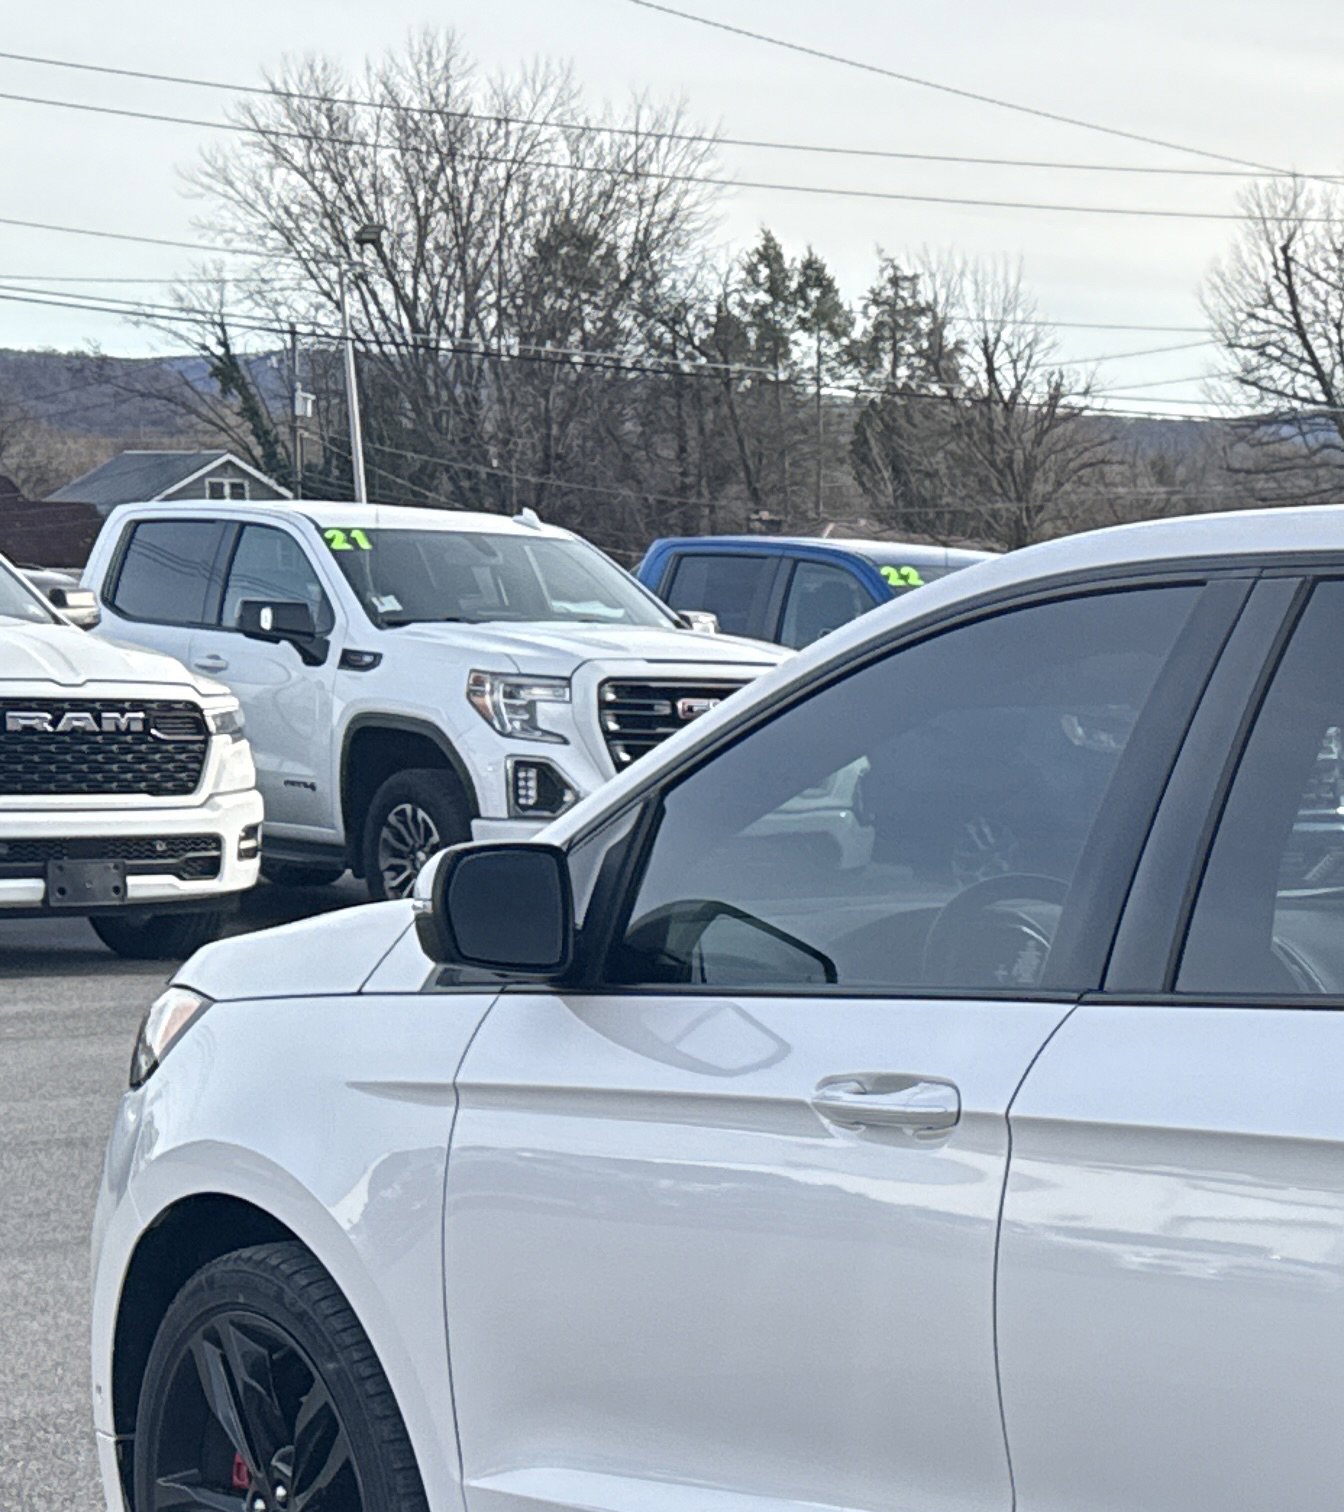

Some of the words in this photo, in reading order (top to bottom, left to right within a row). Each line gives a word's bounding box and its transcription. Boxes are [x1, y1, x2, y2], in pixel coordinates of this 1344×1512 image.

[323, 528, 373, 550] 21
[879, 565, 925, 586] 22
[5, 711, 145, 732] RAM
